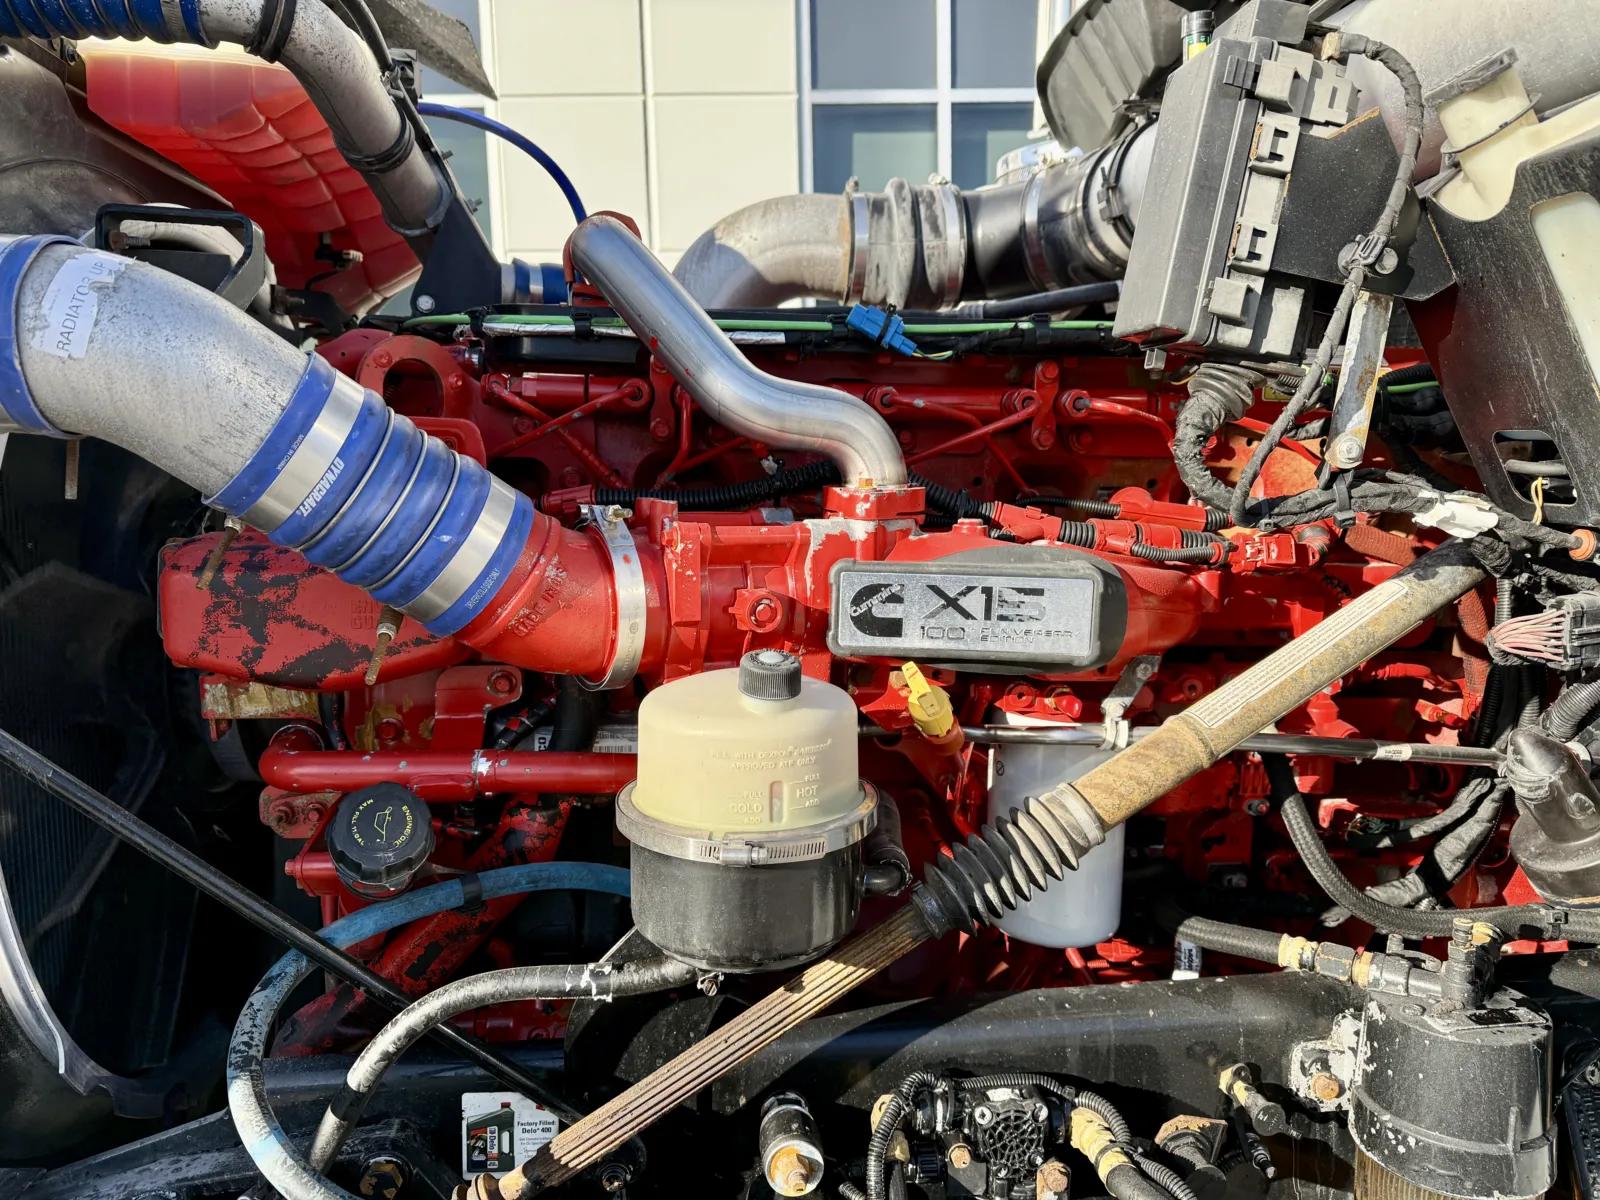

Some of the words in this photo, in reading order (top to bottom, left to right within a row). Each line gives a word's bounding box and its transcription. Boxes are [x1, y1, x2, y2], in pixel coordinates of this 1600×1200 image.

[56, 276, 91, 352] RADIATOR
[796, 785, 818, 798] HOT
[359, 799, 374, 810] MAX
[401, 805, 413, 836] ENGINE
[488, 1135, 497, 1151] Delo
